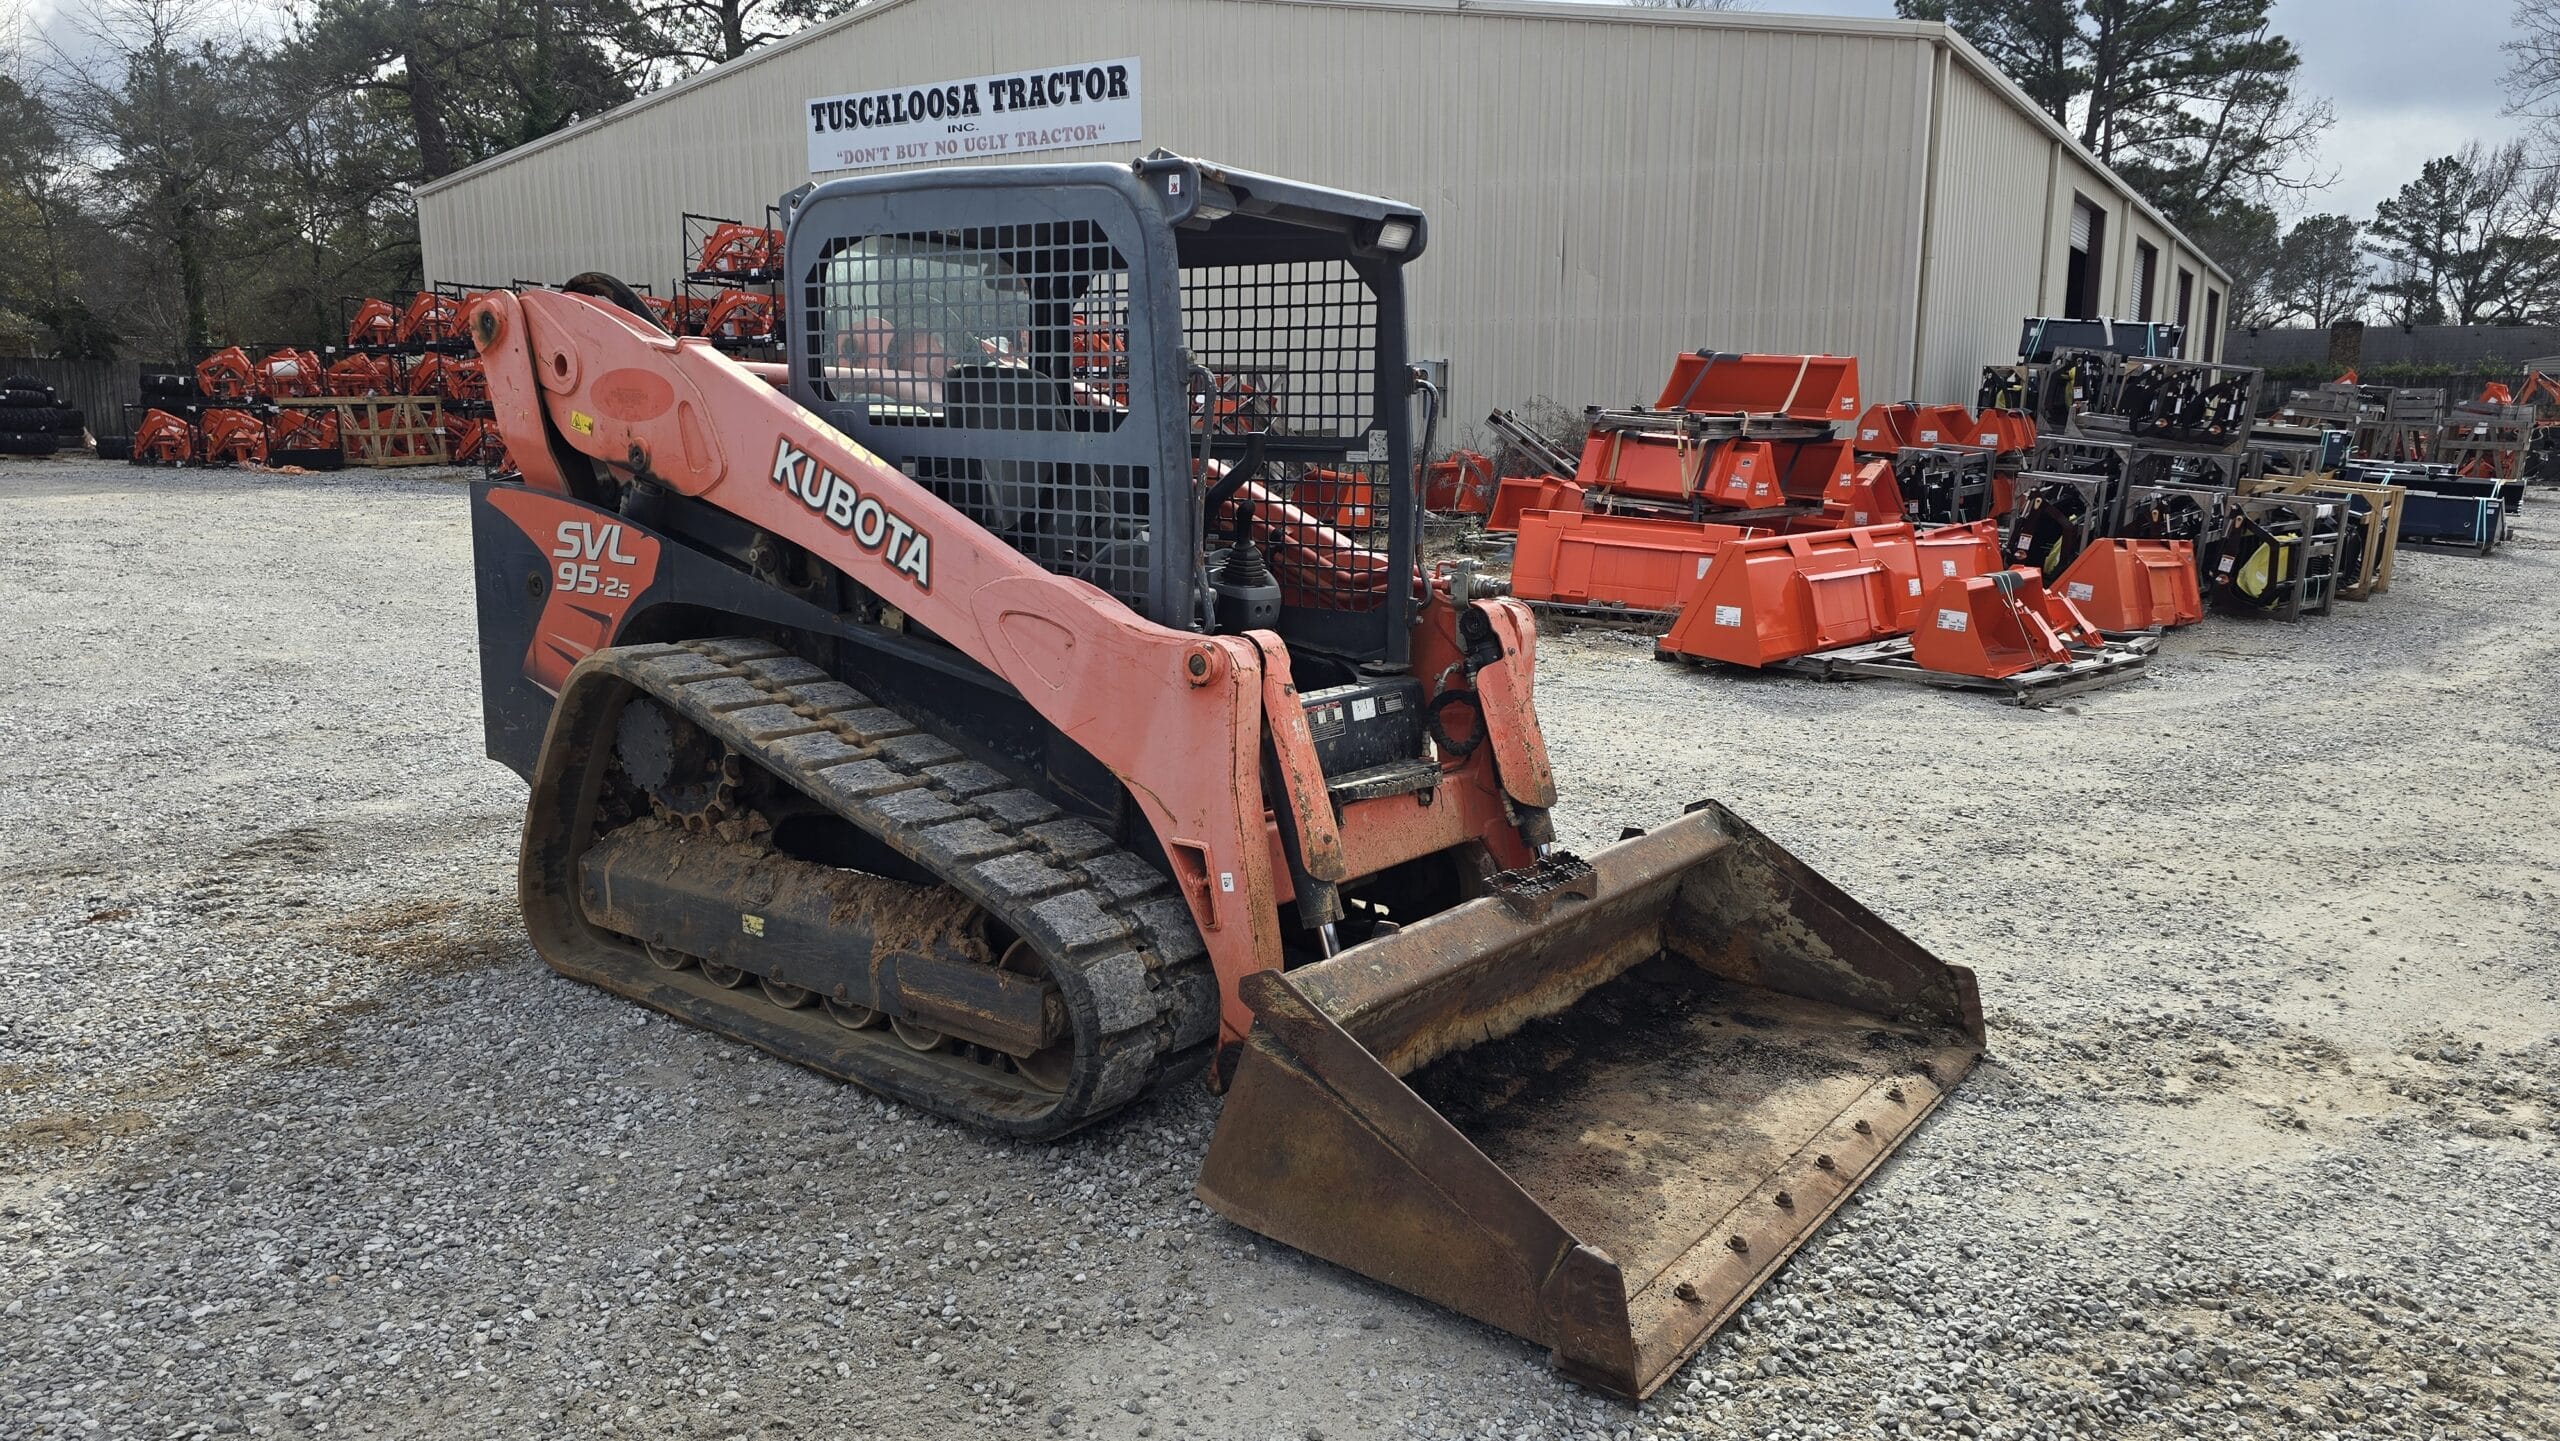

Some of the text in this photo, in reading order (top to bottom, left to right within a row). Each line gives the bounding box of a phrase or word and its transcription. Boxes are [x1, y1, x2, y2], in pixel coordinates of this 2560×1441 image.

[811, 65, 1129, 133] TUSCALOOSA TRACTOR
[896, 142, 929, 160] BUY
[936, 138, 958, 156] NO
[964, 133, 1009, 152] UGLY
[948, 122, 980, 133] INC.
[772, 437, 931, 587] KUBOTA
[553, 521, 636, 565] SVL
